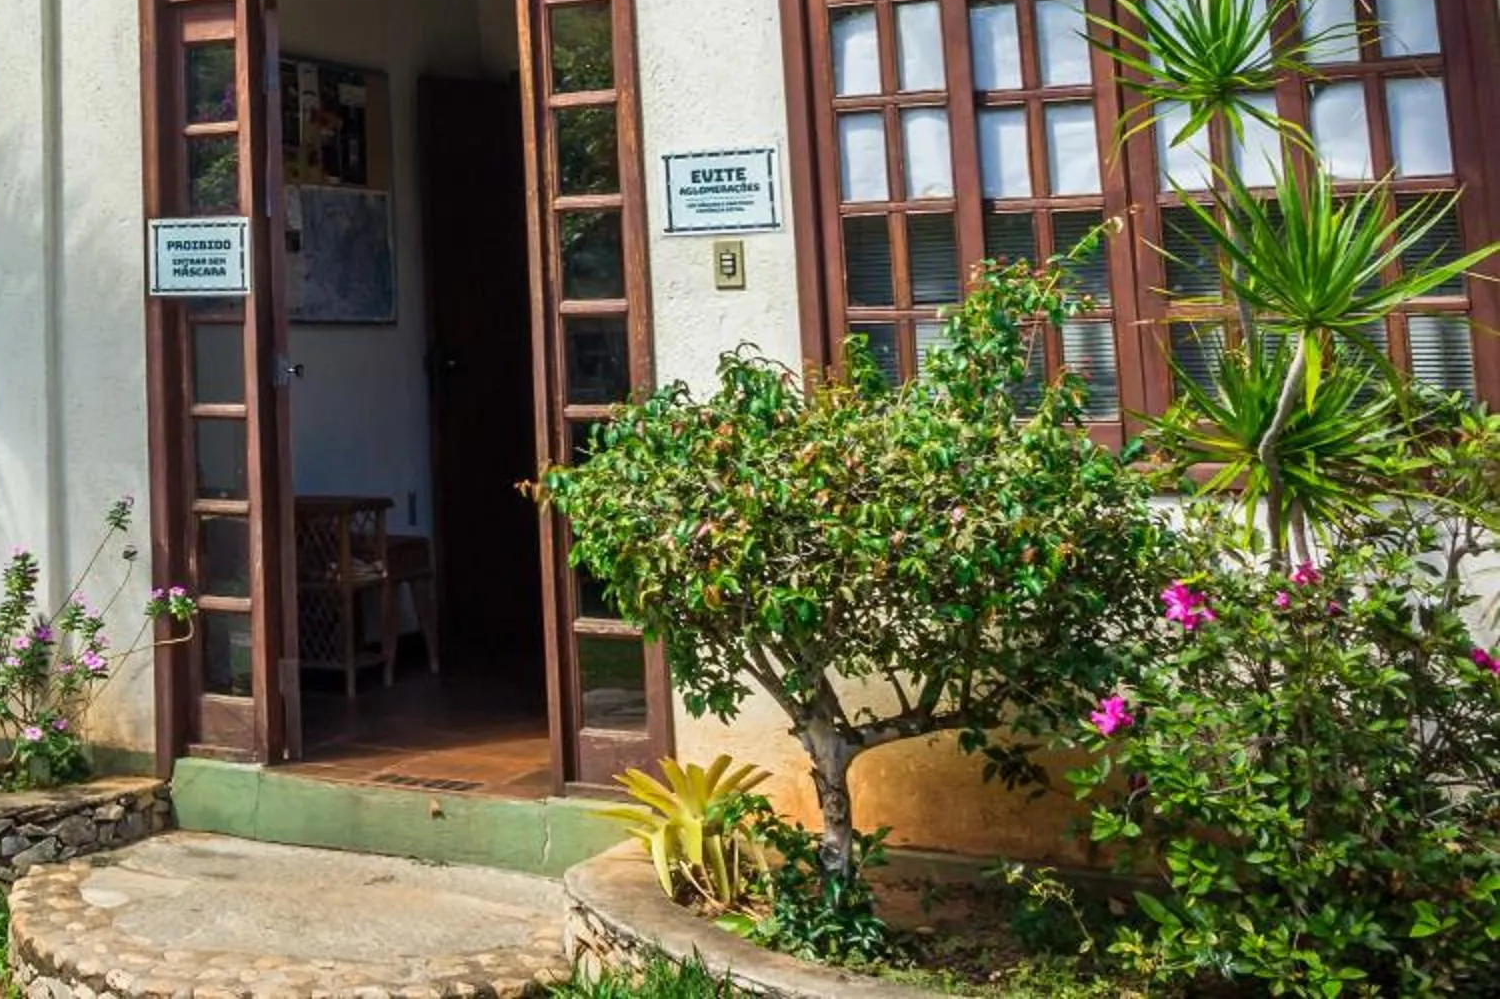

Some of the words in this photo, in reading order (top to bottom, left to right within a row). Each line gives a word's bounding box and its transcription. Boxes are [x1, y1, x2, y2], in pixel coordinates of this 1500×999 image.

[691, 167, 746, 183] EVITE
[167, 240, 231, 250] PROIBIDO
[173, 265, 227, 277] MÁSCARA
